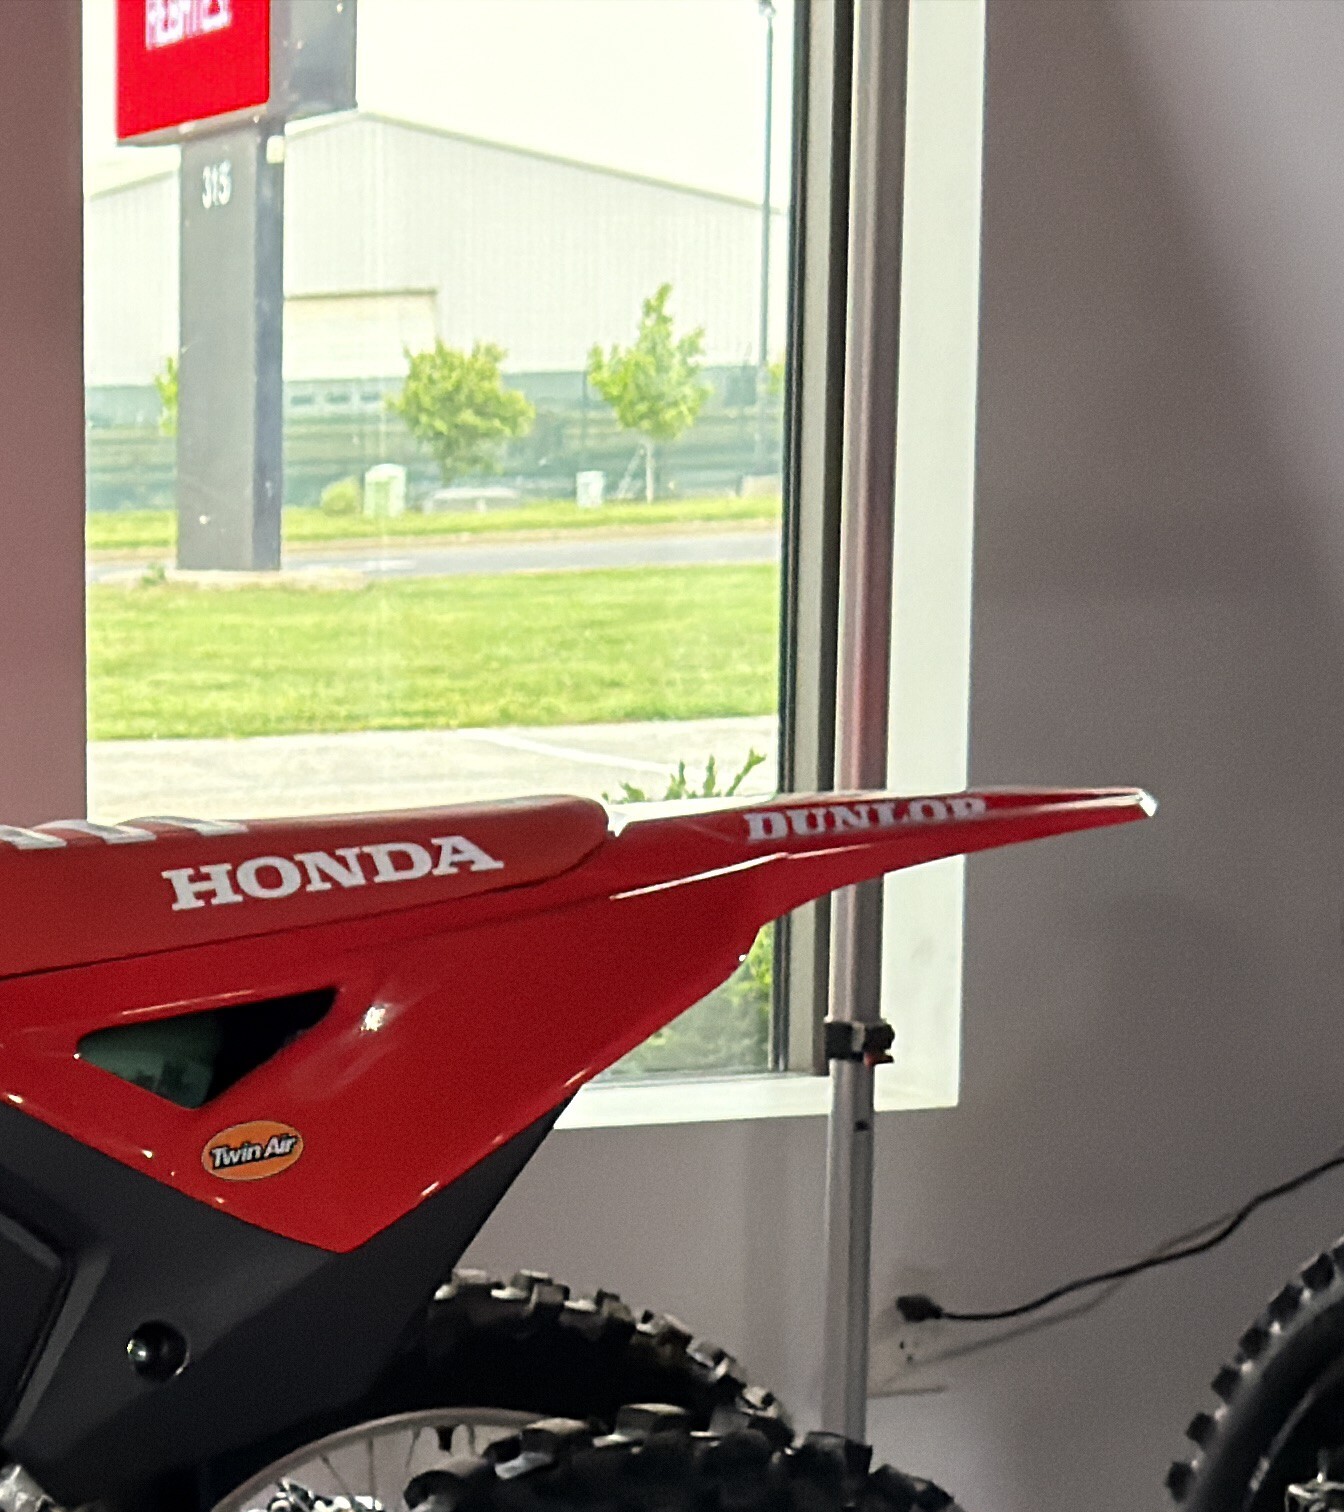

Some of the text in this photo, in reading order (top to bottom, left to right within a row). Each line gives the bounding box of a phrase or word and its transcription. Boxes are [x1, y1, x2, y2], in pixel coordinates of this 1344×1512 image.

[202, 160, 233, 208] 315
[744, 798, 988, 843] DUNLOP
[162, 836, 503, 911] HONDA
[211, 1134, 298, 1168] Twin Air
